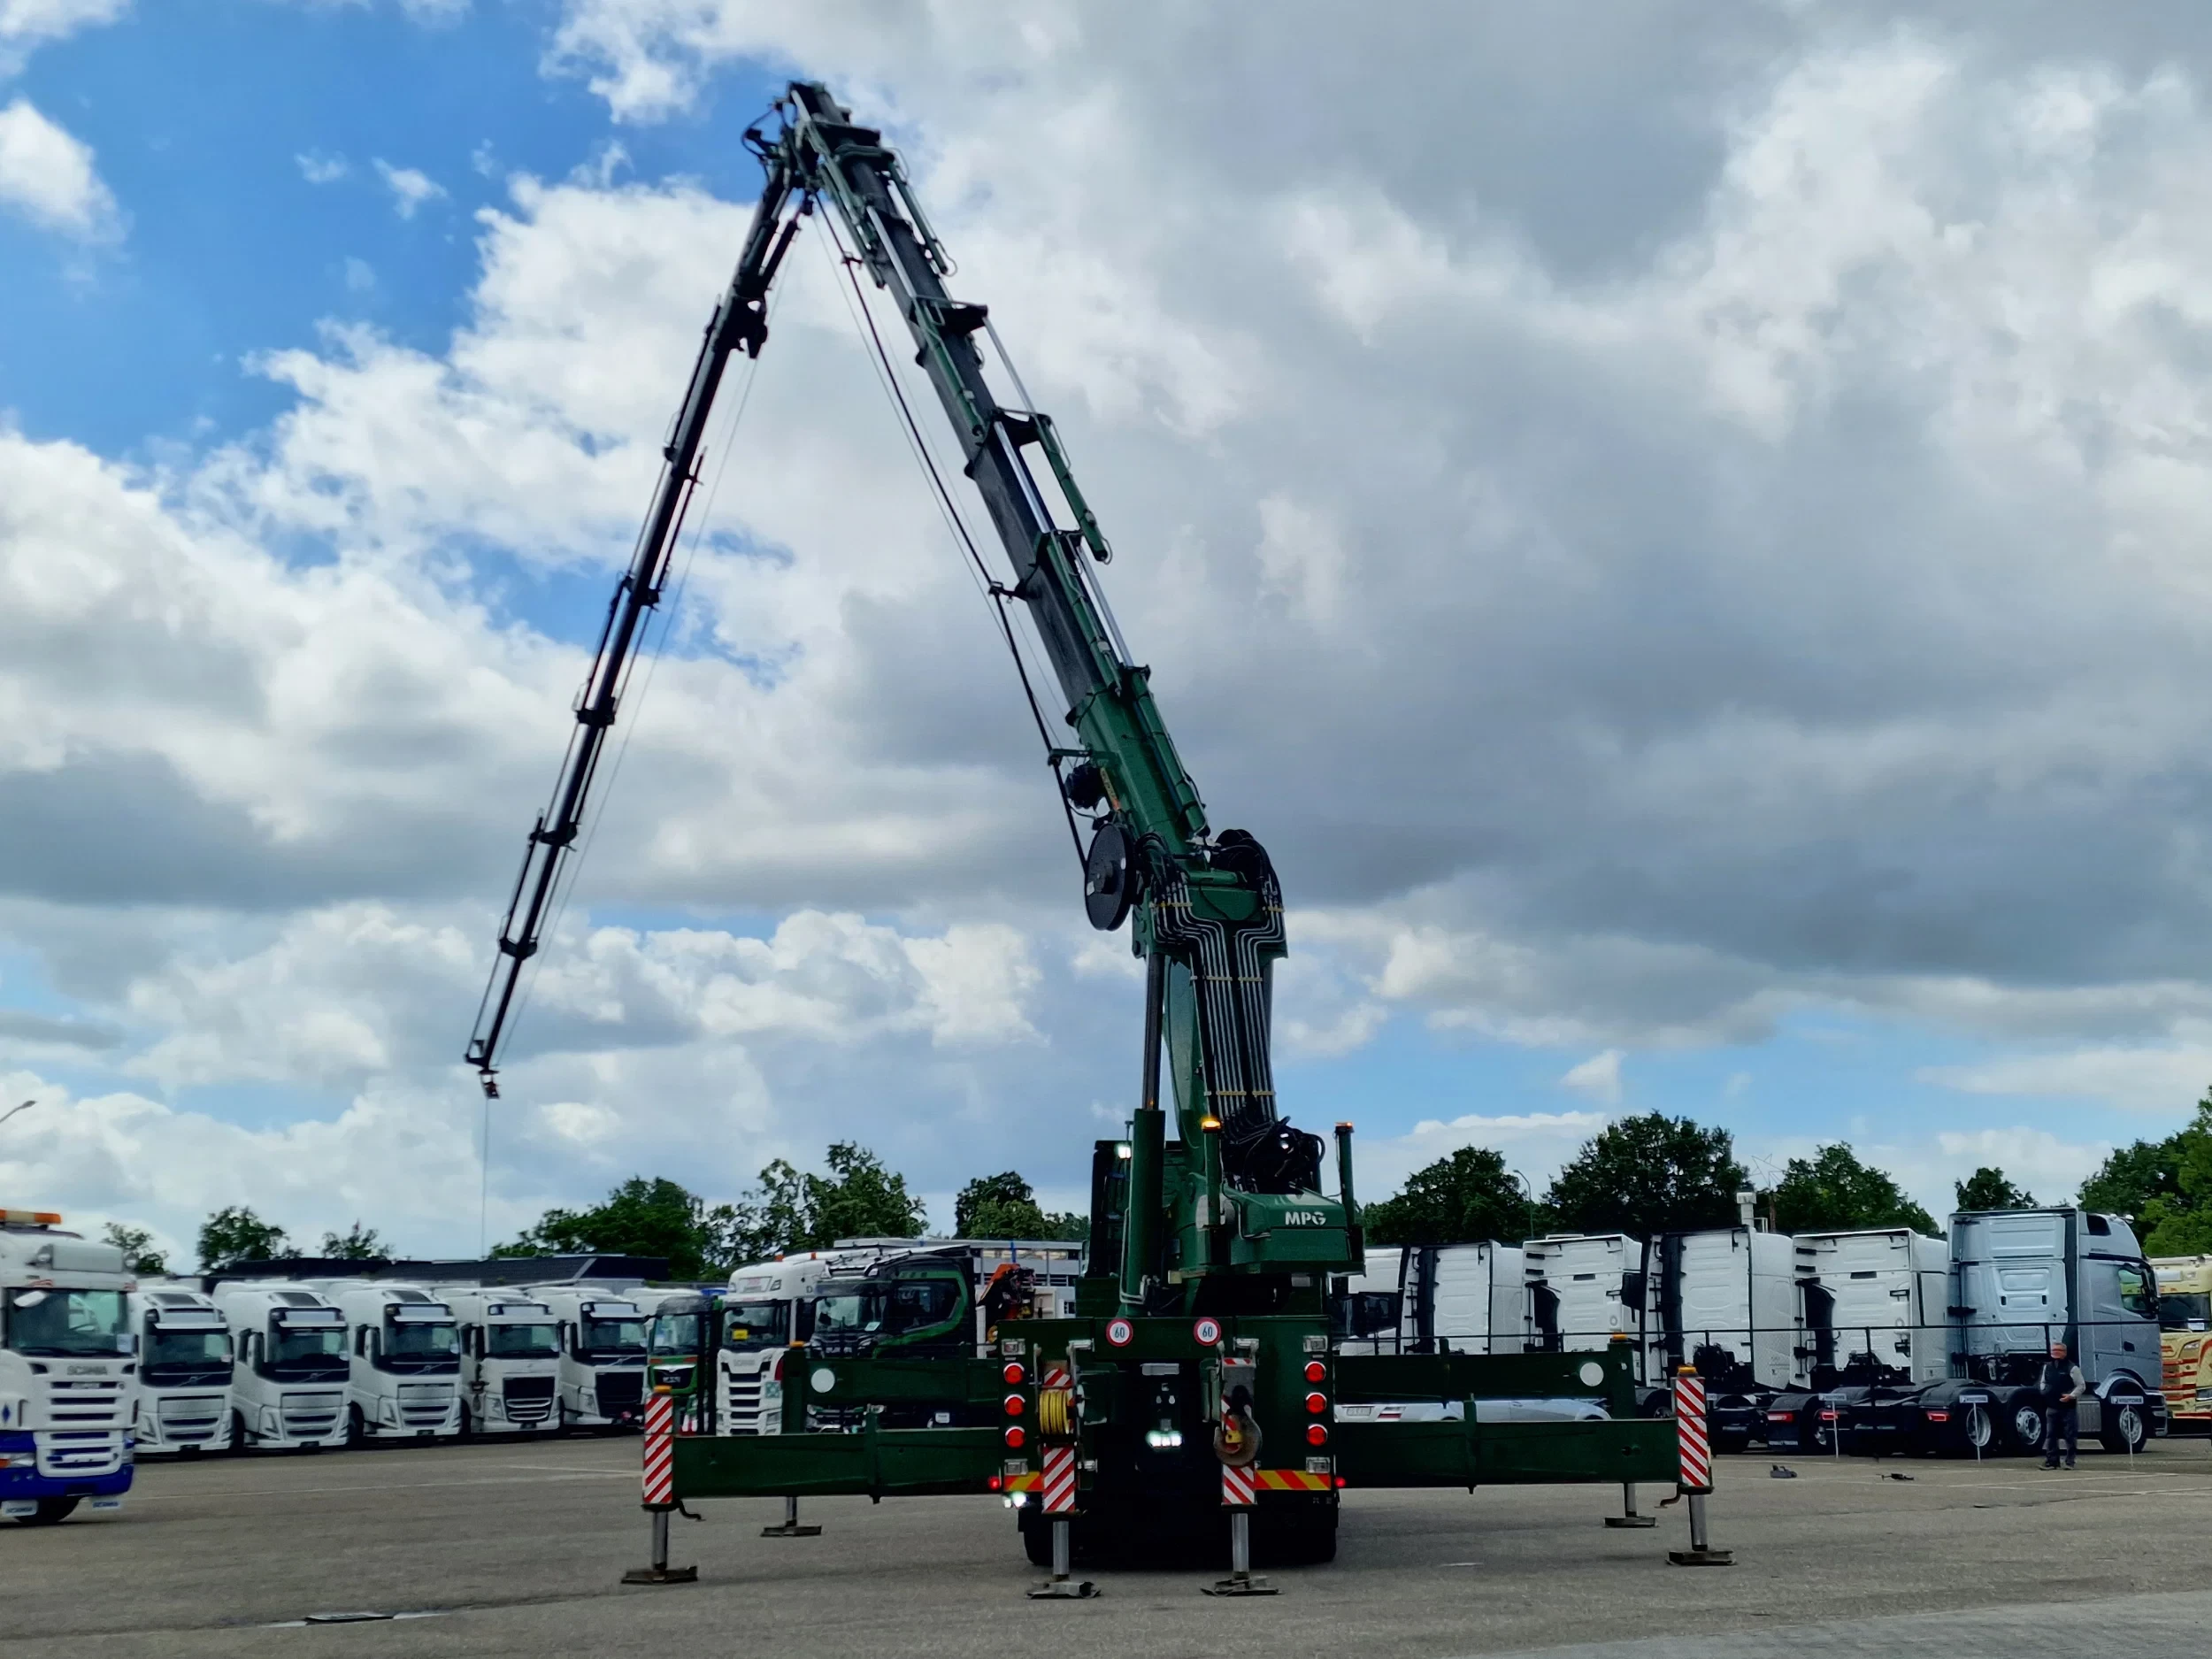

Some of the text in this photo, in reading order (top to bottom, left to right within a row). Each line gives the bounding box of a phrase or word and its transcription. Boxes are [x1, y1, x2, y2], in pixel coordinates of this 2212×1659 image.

[1286, 1211, 1326, 1225] MPG
[1115, 1327, 1125, 1338] 60
[1202, 1326, 1213, 1337] 60
